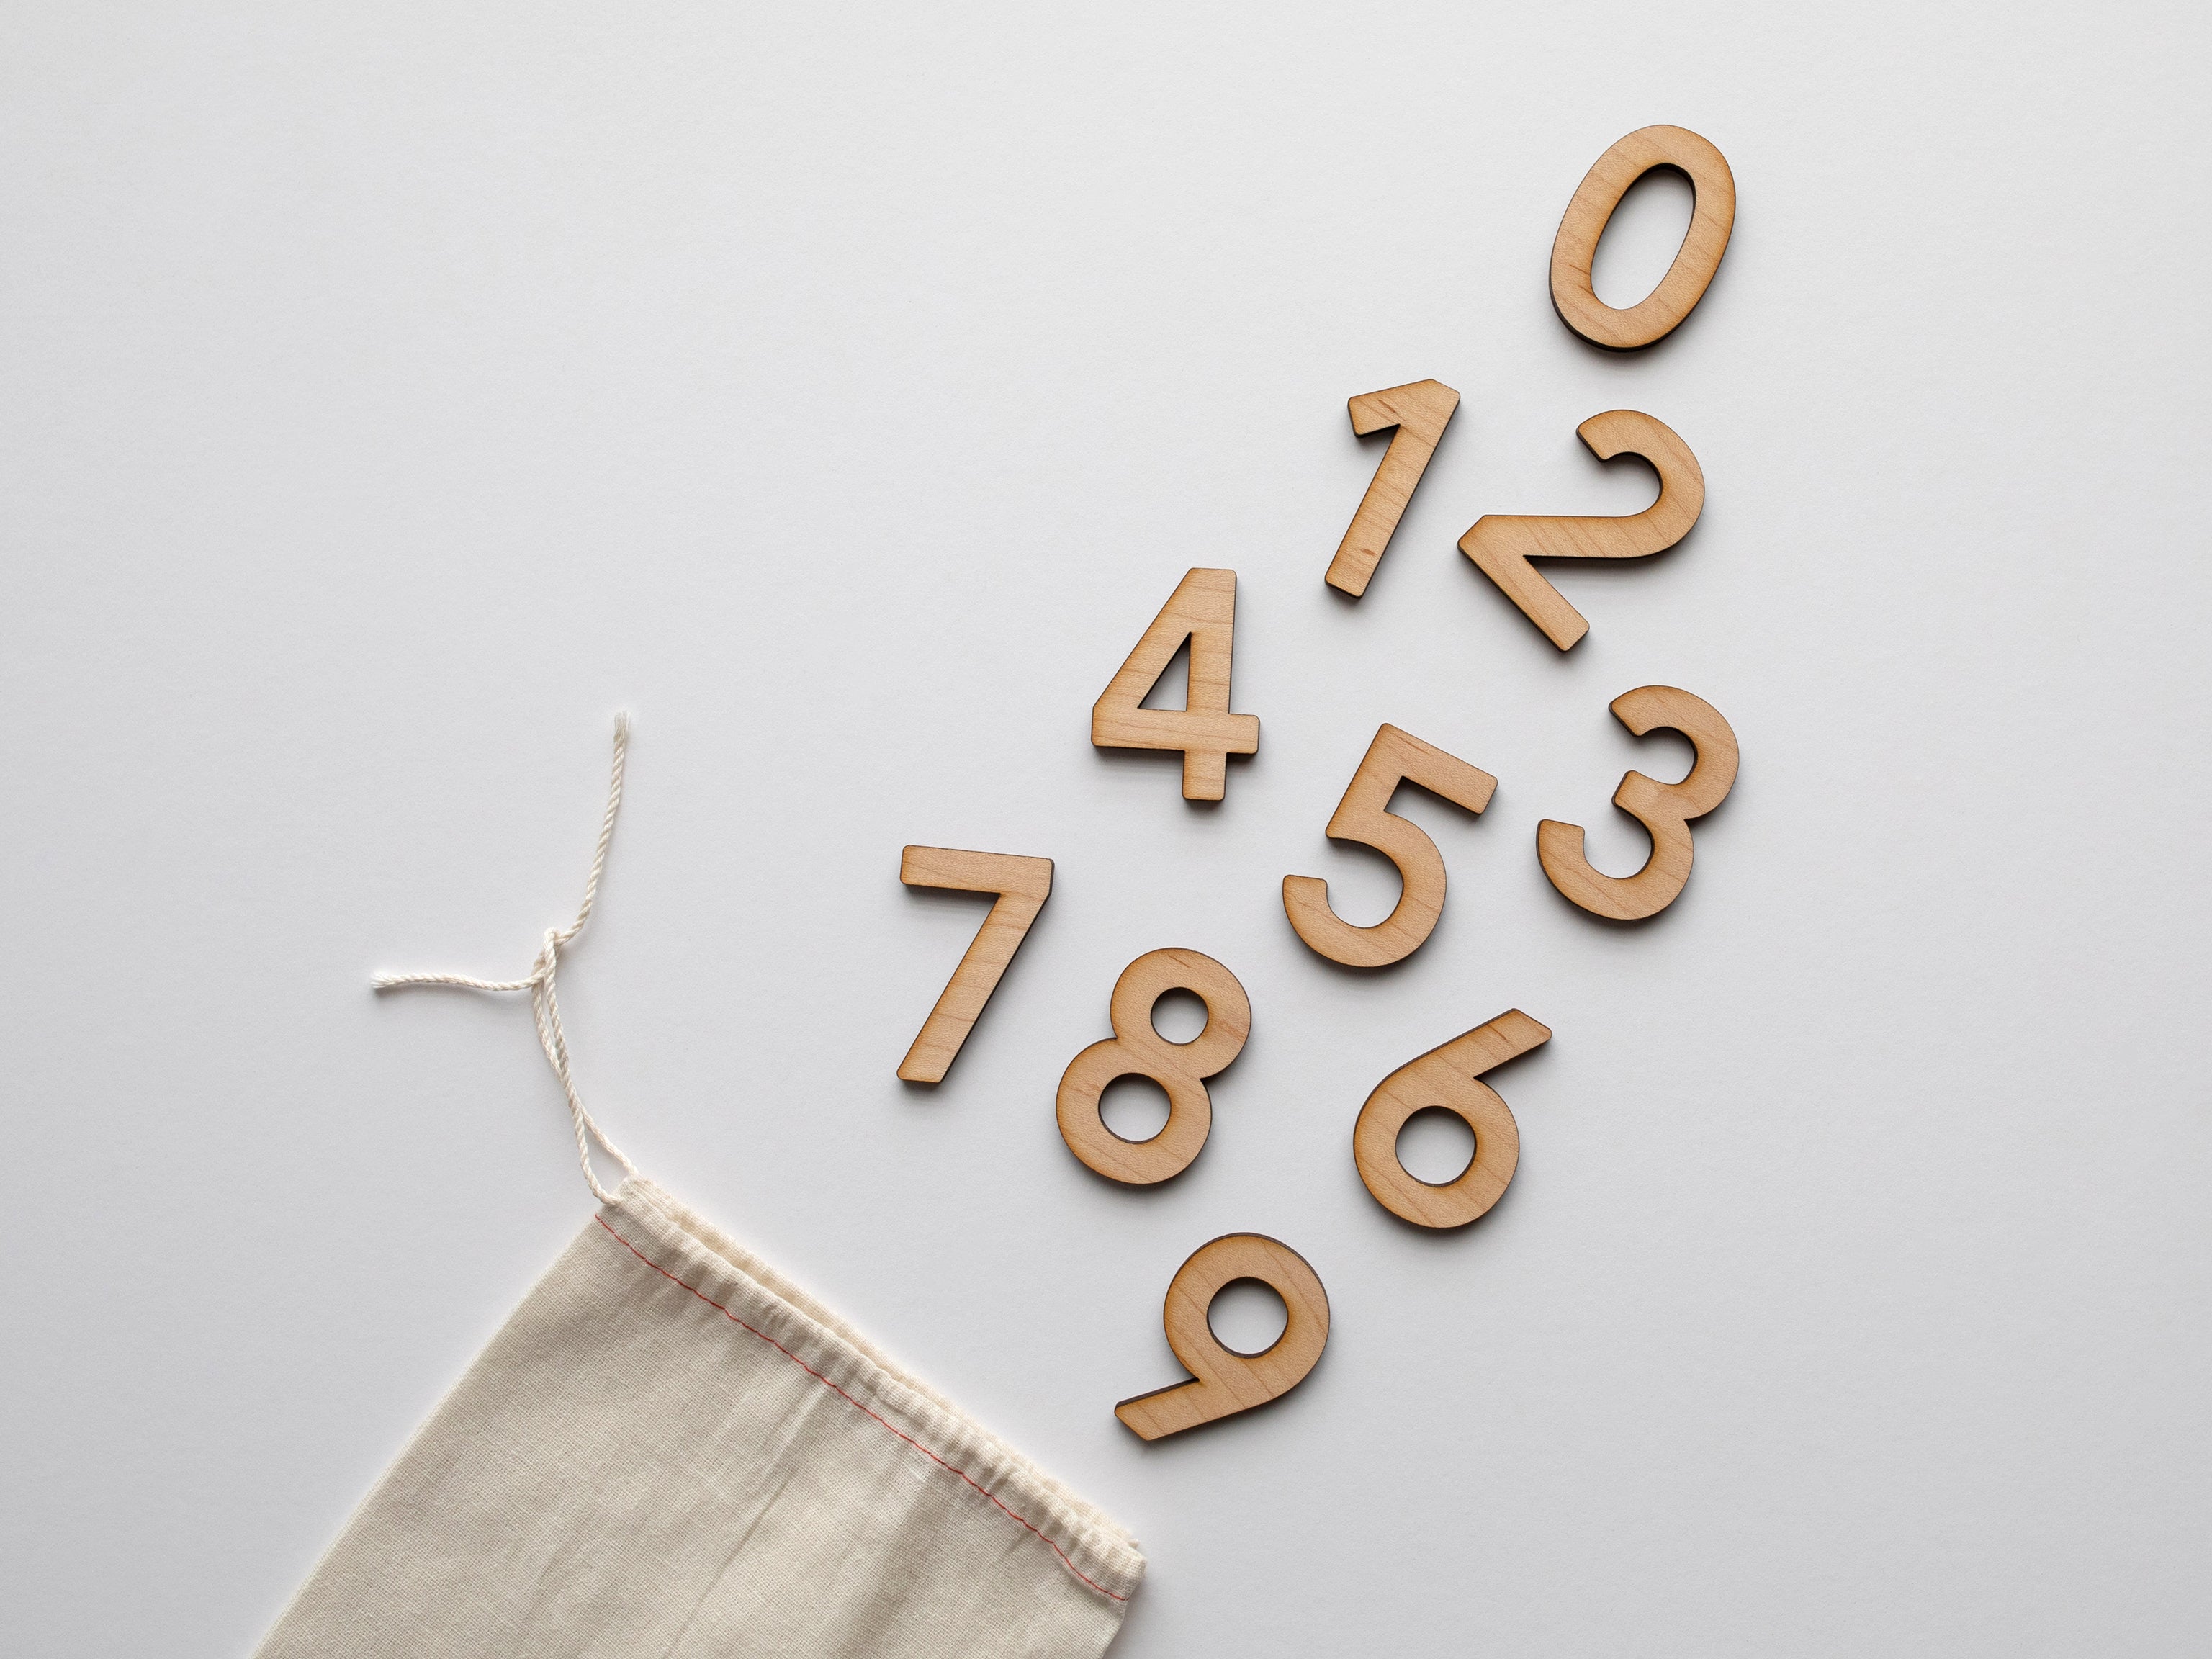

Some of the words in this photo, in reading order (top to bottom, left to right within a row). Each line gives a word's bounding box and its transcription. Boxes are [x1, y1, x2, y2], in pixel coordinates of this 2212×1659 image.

[1550, 125, 1736, 353] 0
[1325, 379, 1460, 599] 1
[1458, 410, 1705, 652] 2
[1091, 568, 1259, 804] 4
[1537, 685, 1739, 923] 3
[1283, 724, 1498, 969] 5
[899, 845, 1053, 1087] 7
[1056, 948, 1251, 1186] 8
[1354, 1009, 1552, 1230] 6
[1115, 1233, 1330, 1443] 9
